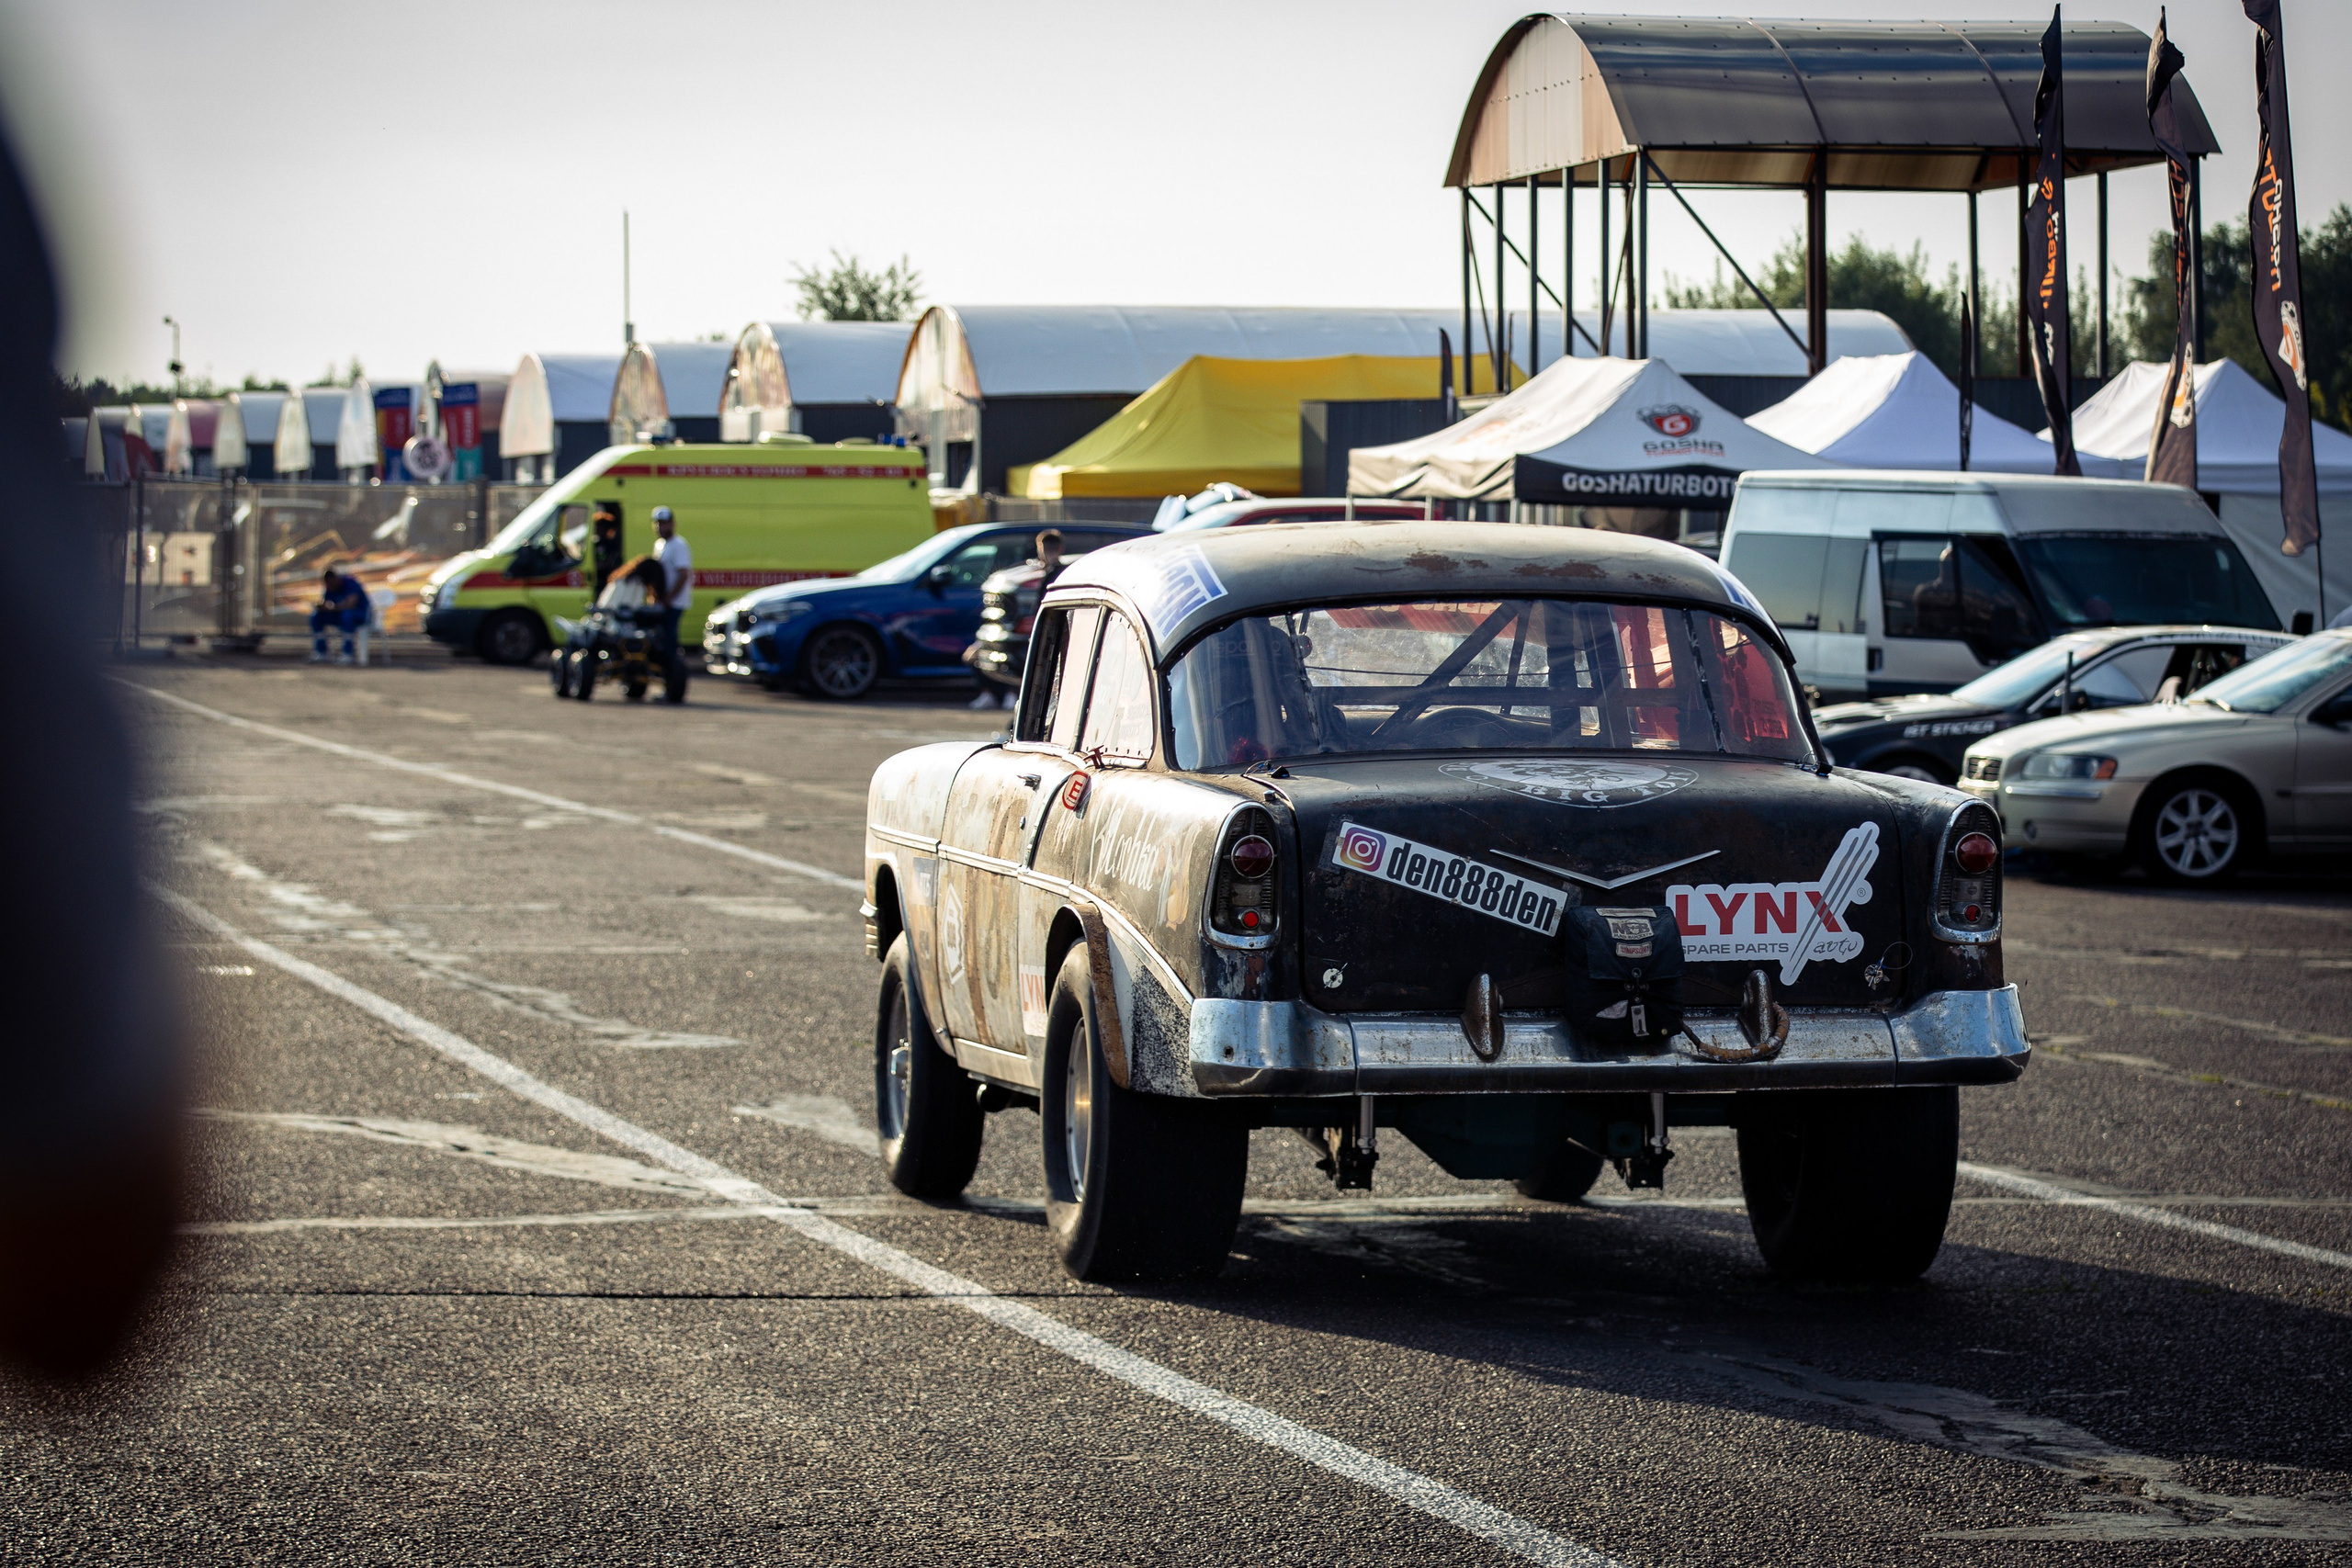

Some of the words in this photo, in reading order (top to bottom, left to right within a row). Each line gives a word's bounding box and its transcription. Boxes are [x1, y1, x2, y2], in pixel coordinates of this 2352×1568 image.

[1643, 437, 1724, 452] GOSHA
[1563, 471, 1735, 498] GOSHATURBOT
[1385, 841, 1557, 932] den888den
[1675, 890, 1843, 936] LYNX
[1735, 942, 1790, 954] PARTS
[1020, 973, 1046, 1014] LYN
